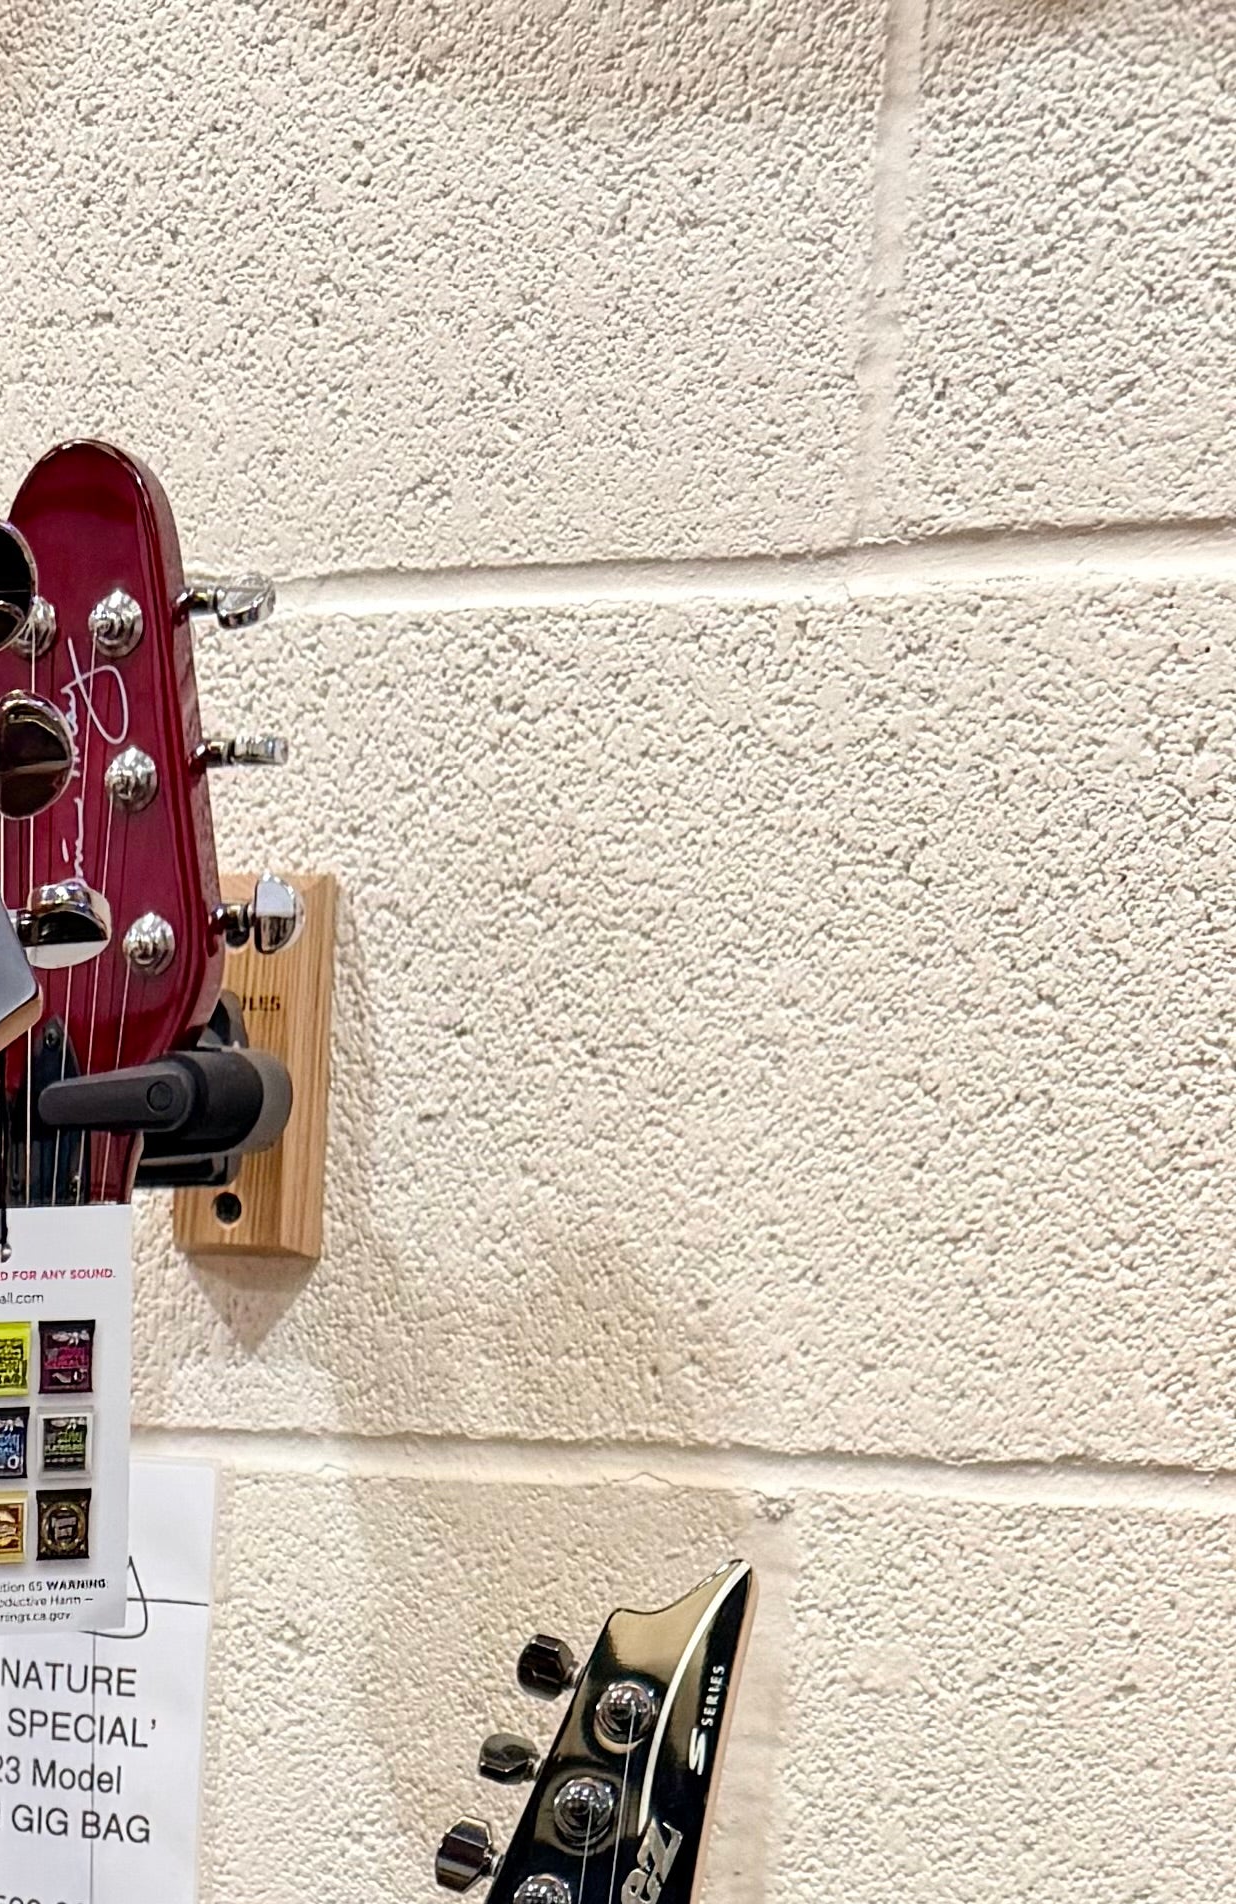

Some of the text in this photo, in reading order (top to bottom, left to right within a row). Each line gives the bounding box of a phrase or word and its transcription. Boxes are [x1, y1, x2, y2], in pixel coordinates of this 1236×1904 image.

[12, 1271, 36, 1281] FOR
[40, 1270, 66, 1280] ANY
[70, 1268, 115, 1279] SOUND.
[28, 1581, 42, 1592] 65
[701, 1665, 725, 1726] SERIES
[31, 1758, 122, 1795] Model
[10, 1803, 68, 1837] GIG
[81, 1811, 151, 1845] BAG
